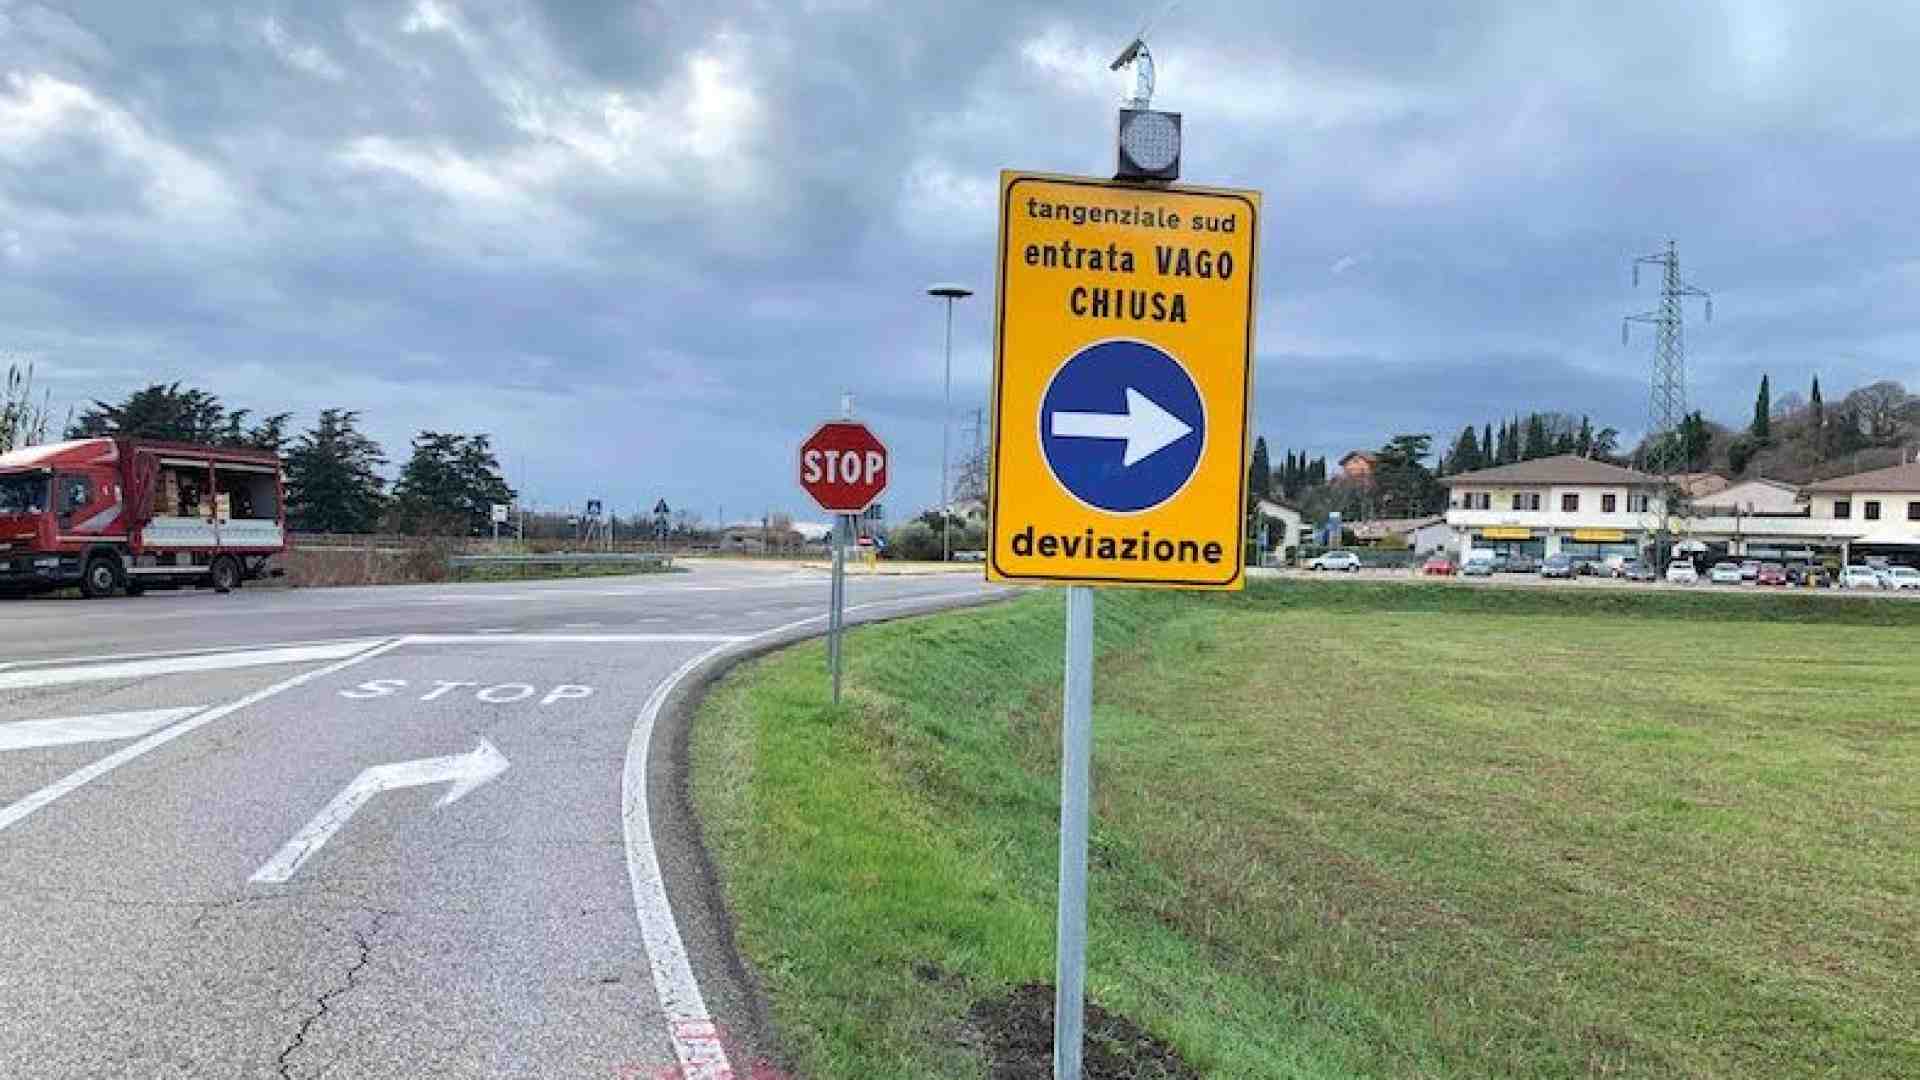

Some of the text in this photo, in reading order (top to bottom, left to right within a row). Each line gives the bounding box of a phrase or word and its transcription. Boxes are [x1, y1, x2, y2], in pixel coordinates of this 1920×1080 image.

[1027, 197, 1236, 233] tangenziale sud
[1024, 240, 1233, 280] entrata VAGO
[1070, 286, 1187, 323] CHIUSA
[804, 450, 884, 485] STOP
[1011, 526, 1223, 563] deviazione
[338, 679, 594, 704] STOP
